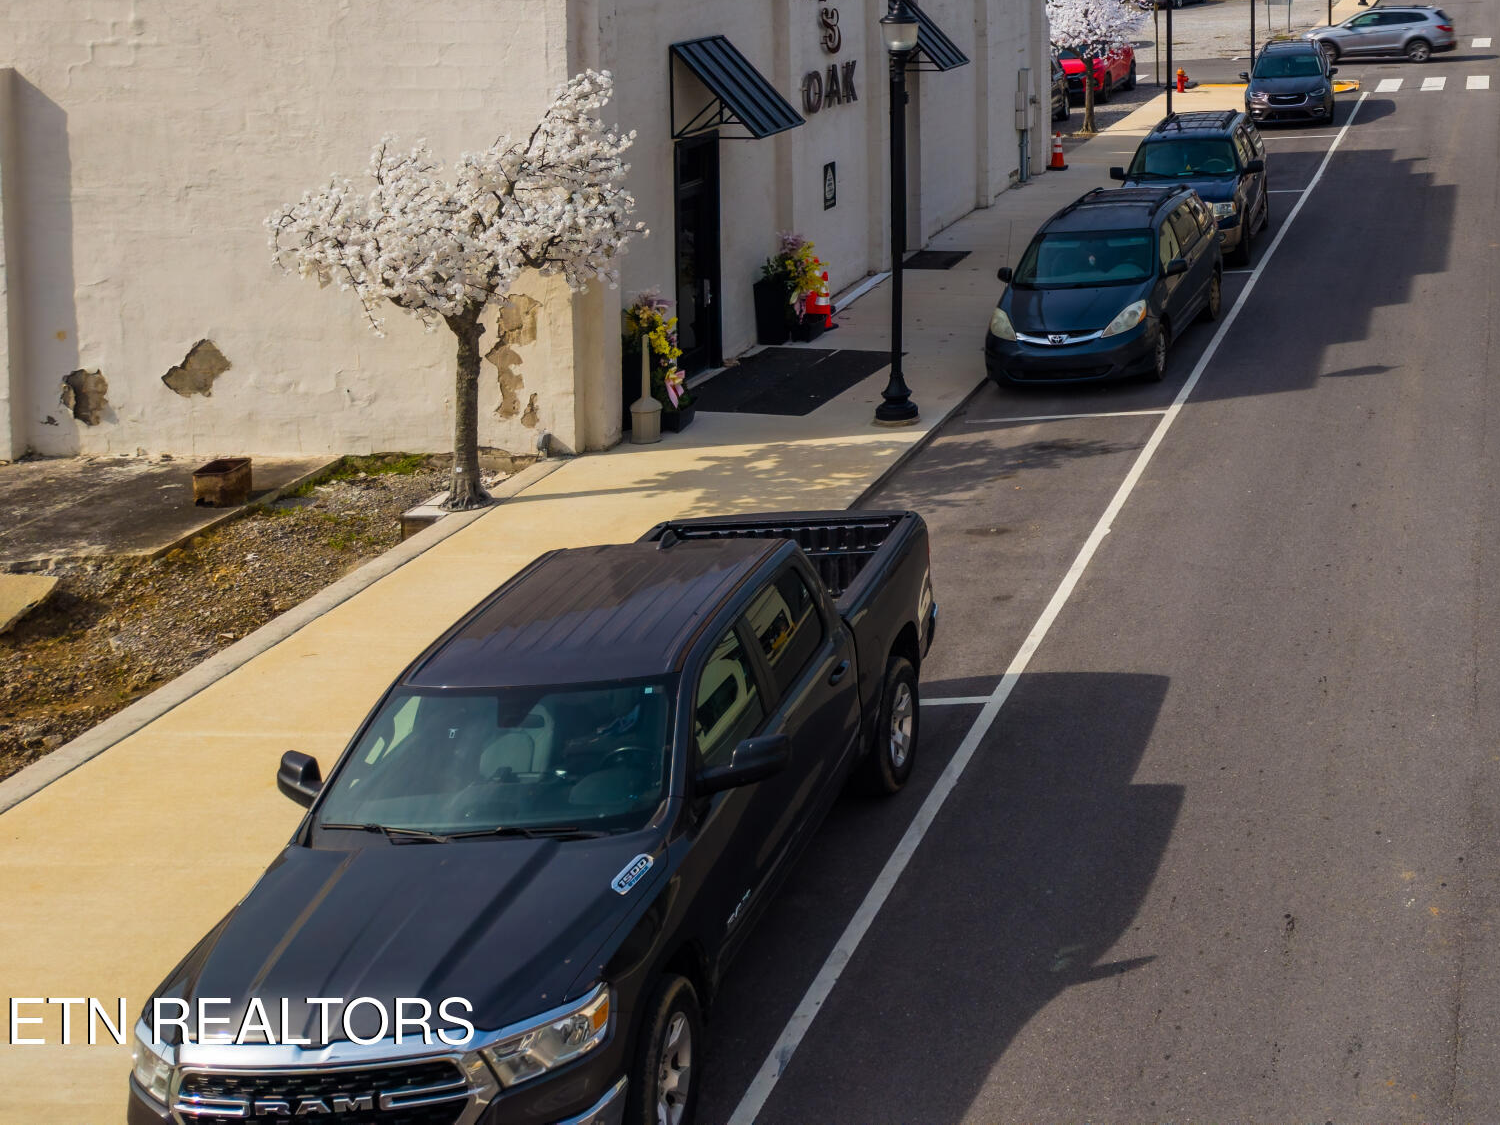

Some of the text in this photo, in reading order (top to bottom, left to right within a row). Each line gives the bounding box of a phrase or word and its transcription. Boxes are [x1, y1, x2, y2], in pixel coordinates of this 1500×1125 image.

[804, 59, 858, 114] OAK
[618, 858, 647, 887] 1500
[254, 1095, 375, 1116] RAM
